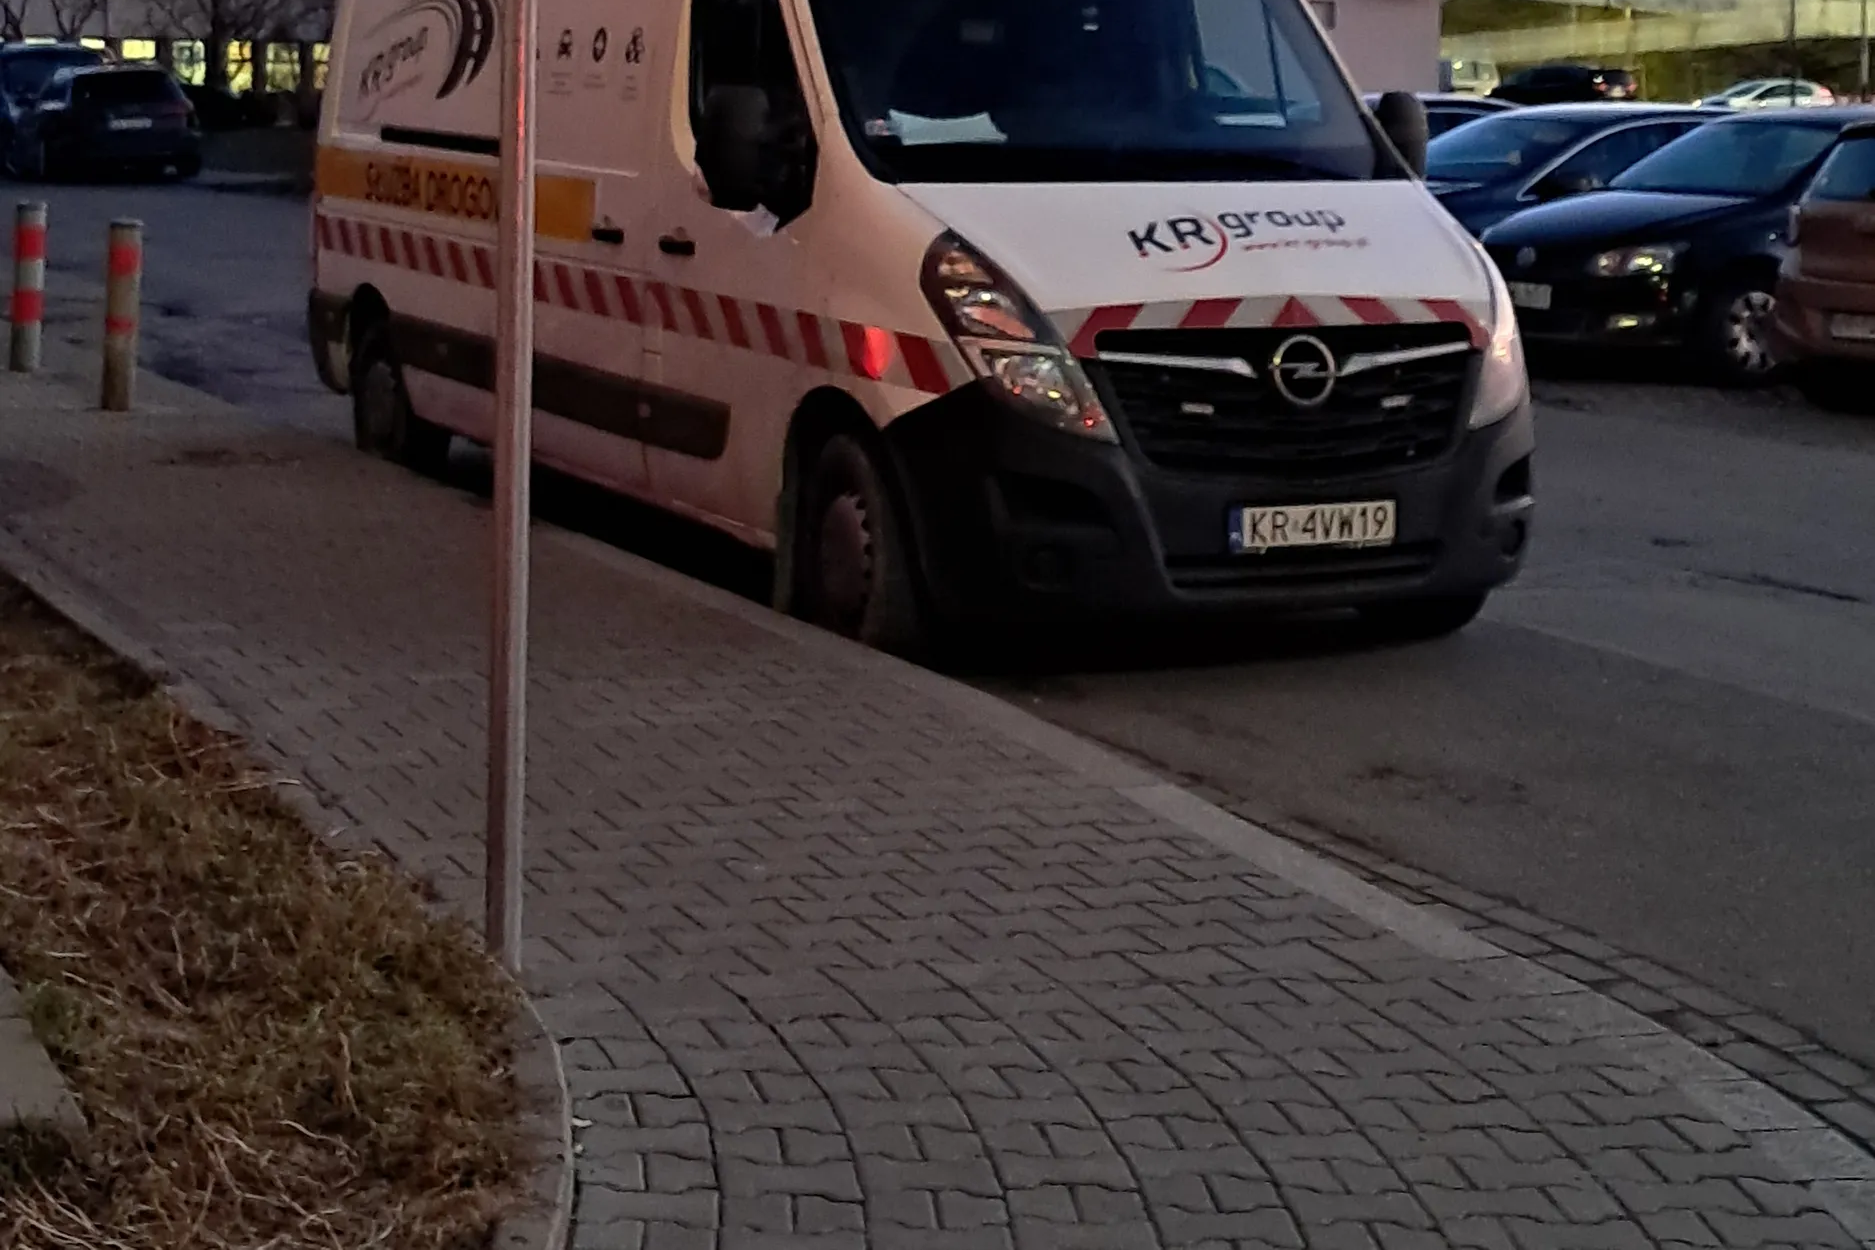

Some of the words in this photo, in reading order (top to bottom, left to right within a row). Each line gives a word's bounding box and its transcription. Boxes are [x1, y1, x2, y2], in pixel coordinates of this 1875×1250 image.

[424, 168, 501, 225] DROGO
[1216, 210, 1346, 239] group
[1250, 510, 1290, 544] KR
[1301, 505, 1389, 540] 4VW19
